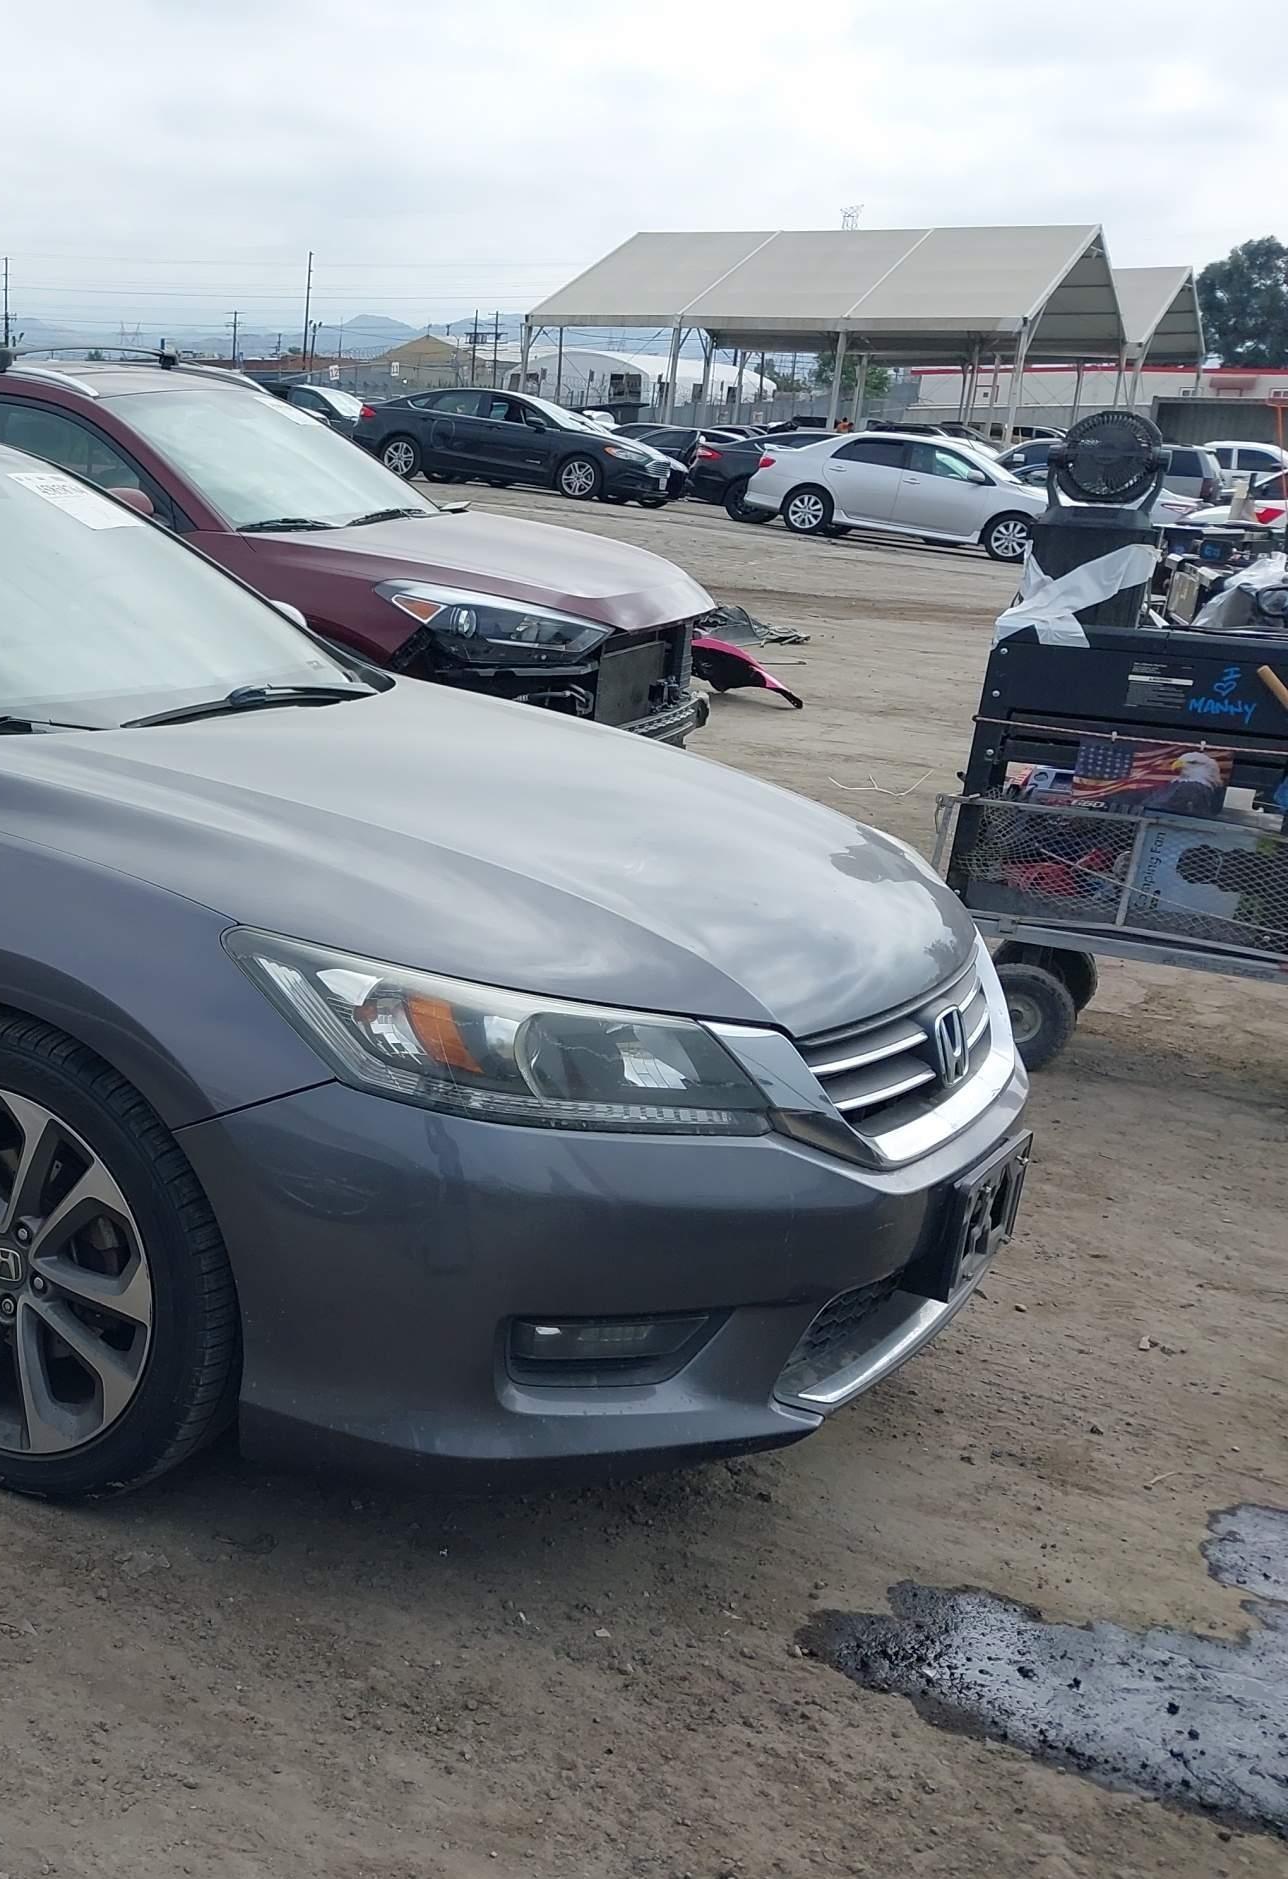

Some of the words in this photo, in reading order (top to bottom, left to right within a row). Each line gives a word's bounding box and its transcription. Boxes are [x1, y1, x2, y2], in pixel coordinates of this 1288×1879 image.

[1223, 667, 1242, 681] I
[1188, 697, 1256, 724] MANNY
[1150, 832, 1167, 854] Fan
